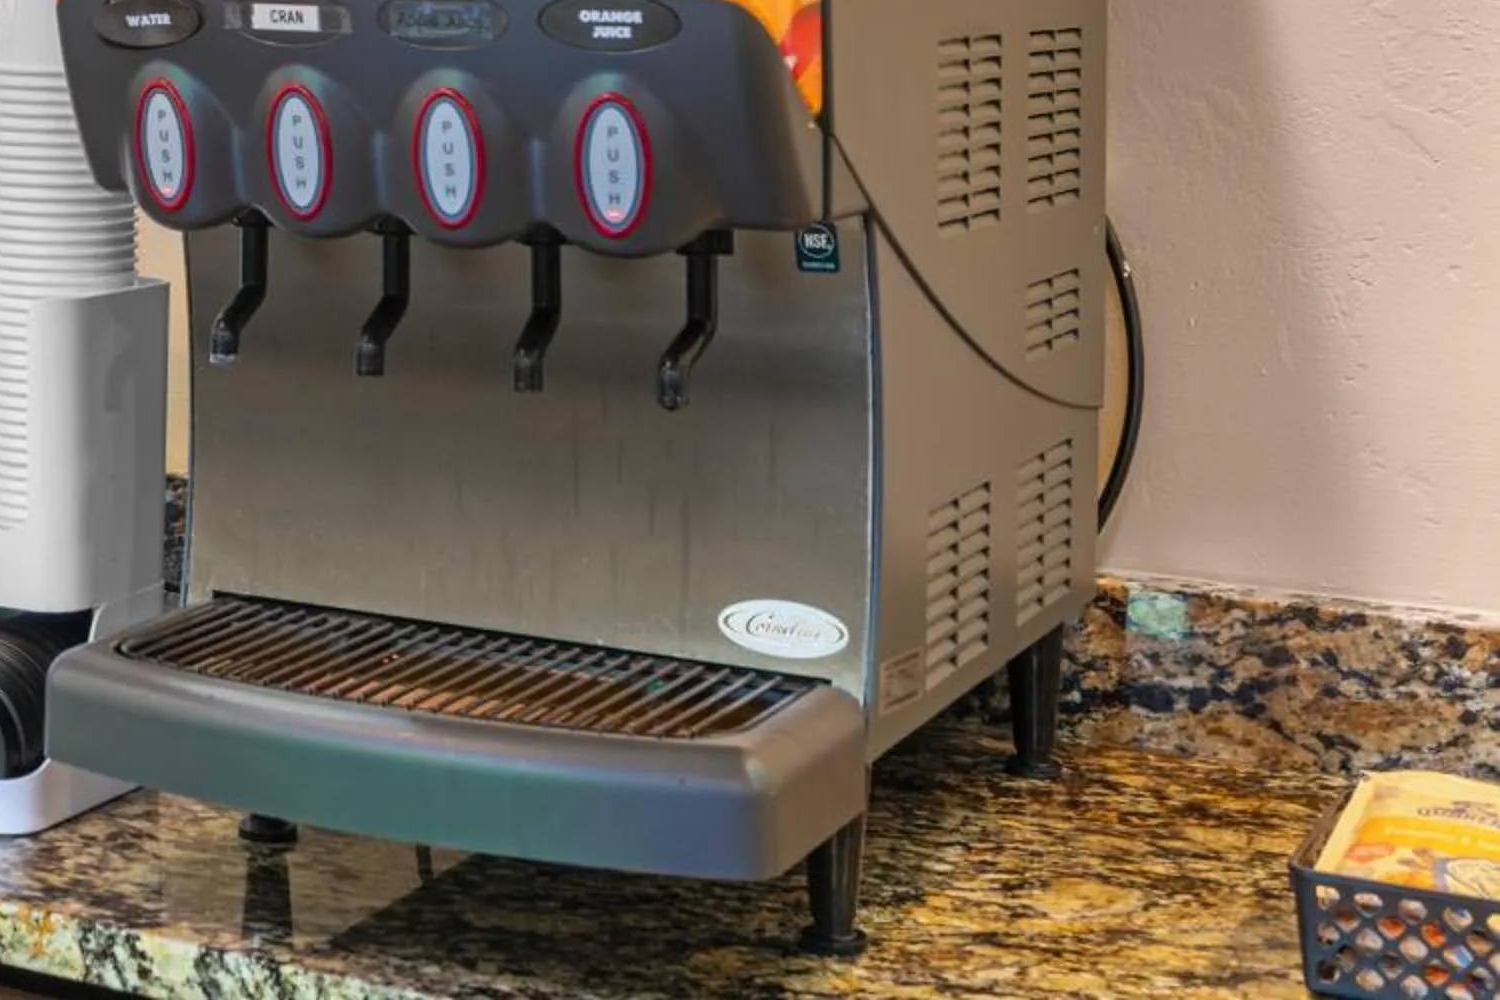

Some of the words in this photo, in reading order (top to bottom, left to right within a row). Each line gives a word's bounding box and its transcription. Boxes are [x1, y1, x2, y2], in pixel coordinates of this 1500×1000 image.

[269, 9, 304, 24] CRAN
[579, 9, 643, 24] ORANGE
[592, 25, 632, 39] JUICE
[441, 120, 457, 199] PUSH
[606, 126, 621, 205] PUSH
